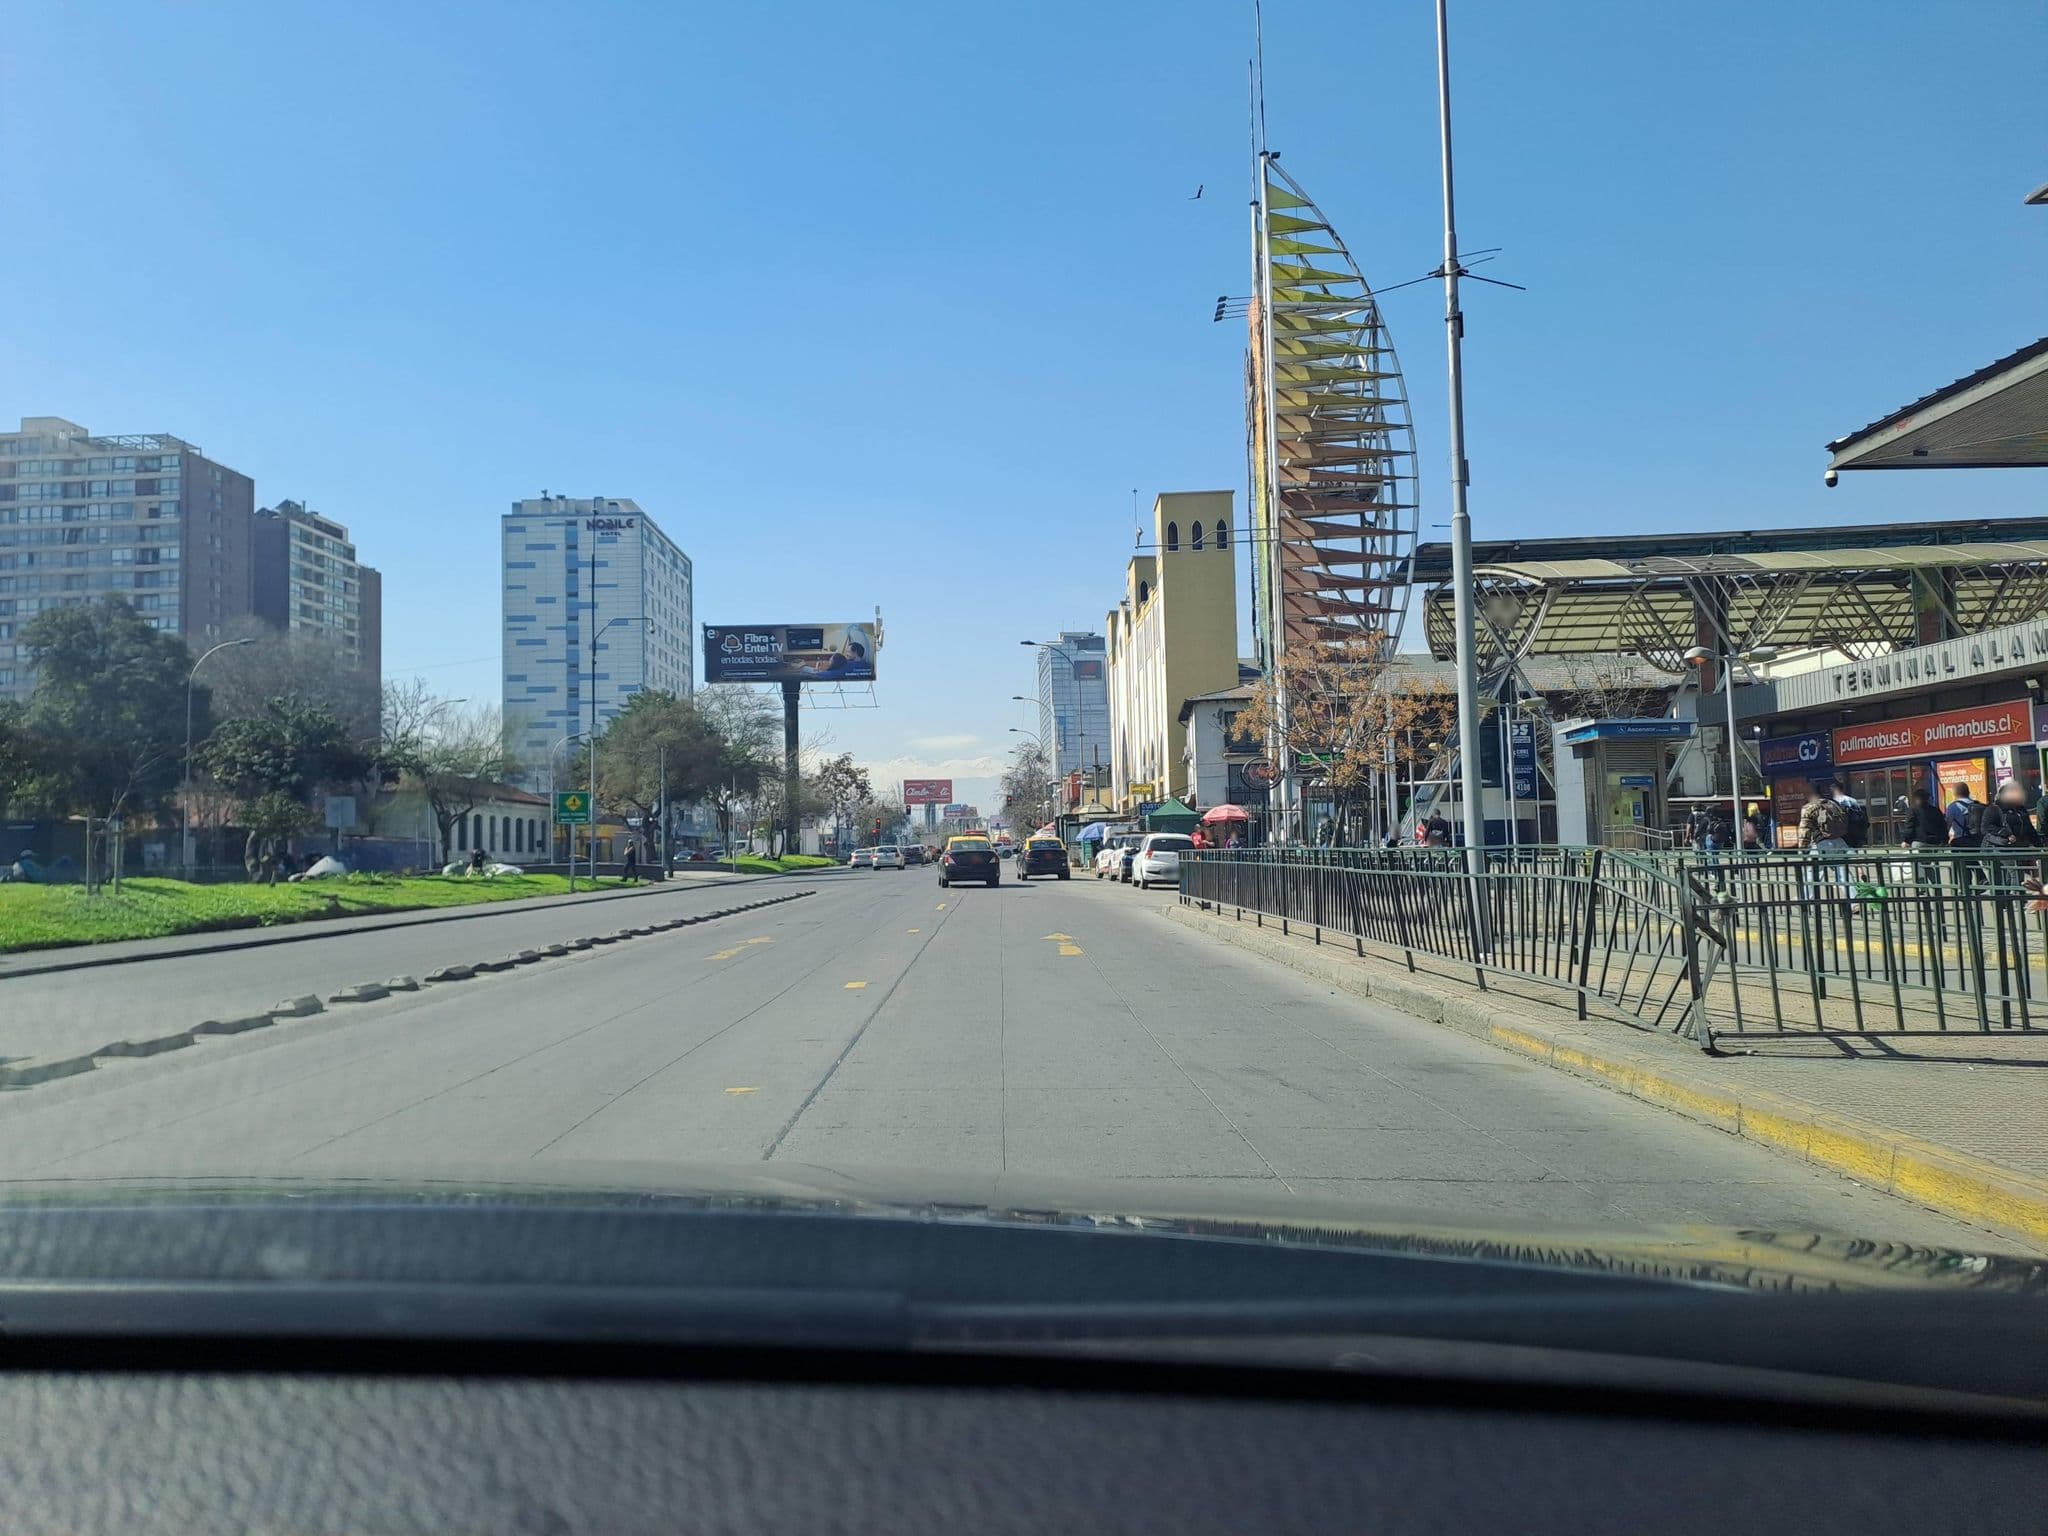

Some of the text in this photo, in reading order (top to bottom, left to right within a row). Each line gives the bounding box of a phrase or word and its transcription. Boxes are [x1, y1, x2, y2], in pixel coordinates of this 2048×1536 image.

[586, 518, 635, 531] NOBILE
[744, 633, 769, 642] Fibra
[744, 643, 783, 653] Entel TV
[1832, 650, 1955, 694] TERMINAL
[1924, 714, 2012, 745] pullmanbus.cl
[1799, 739, 1819, 760] GO
[1840, 728, 1911, 757] pullmanbus.cl
